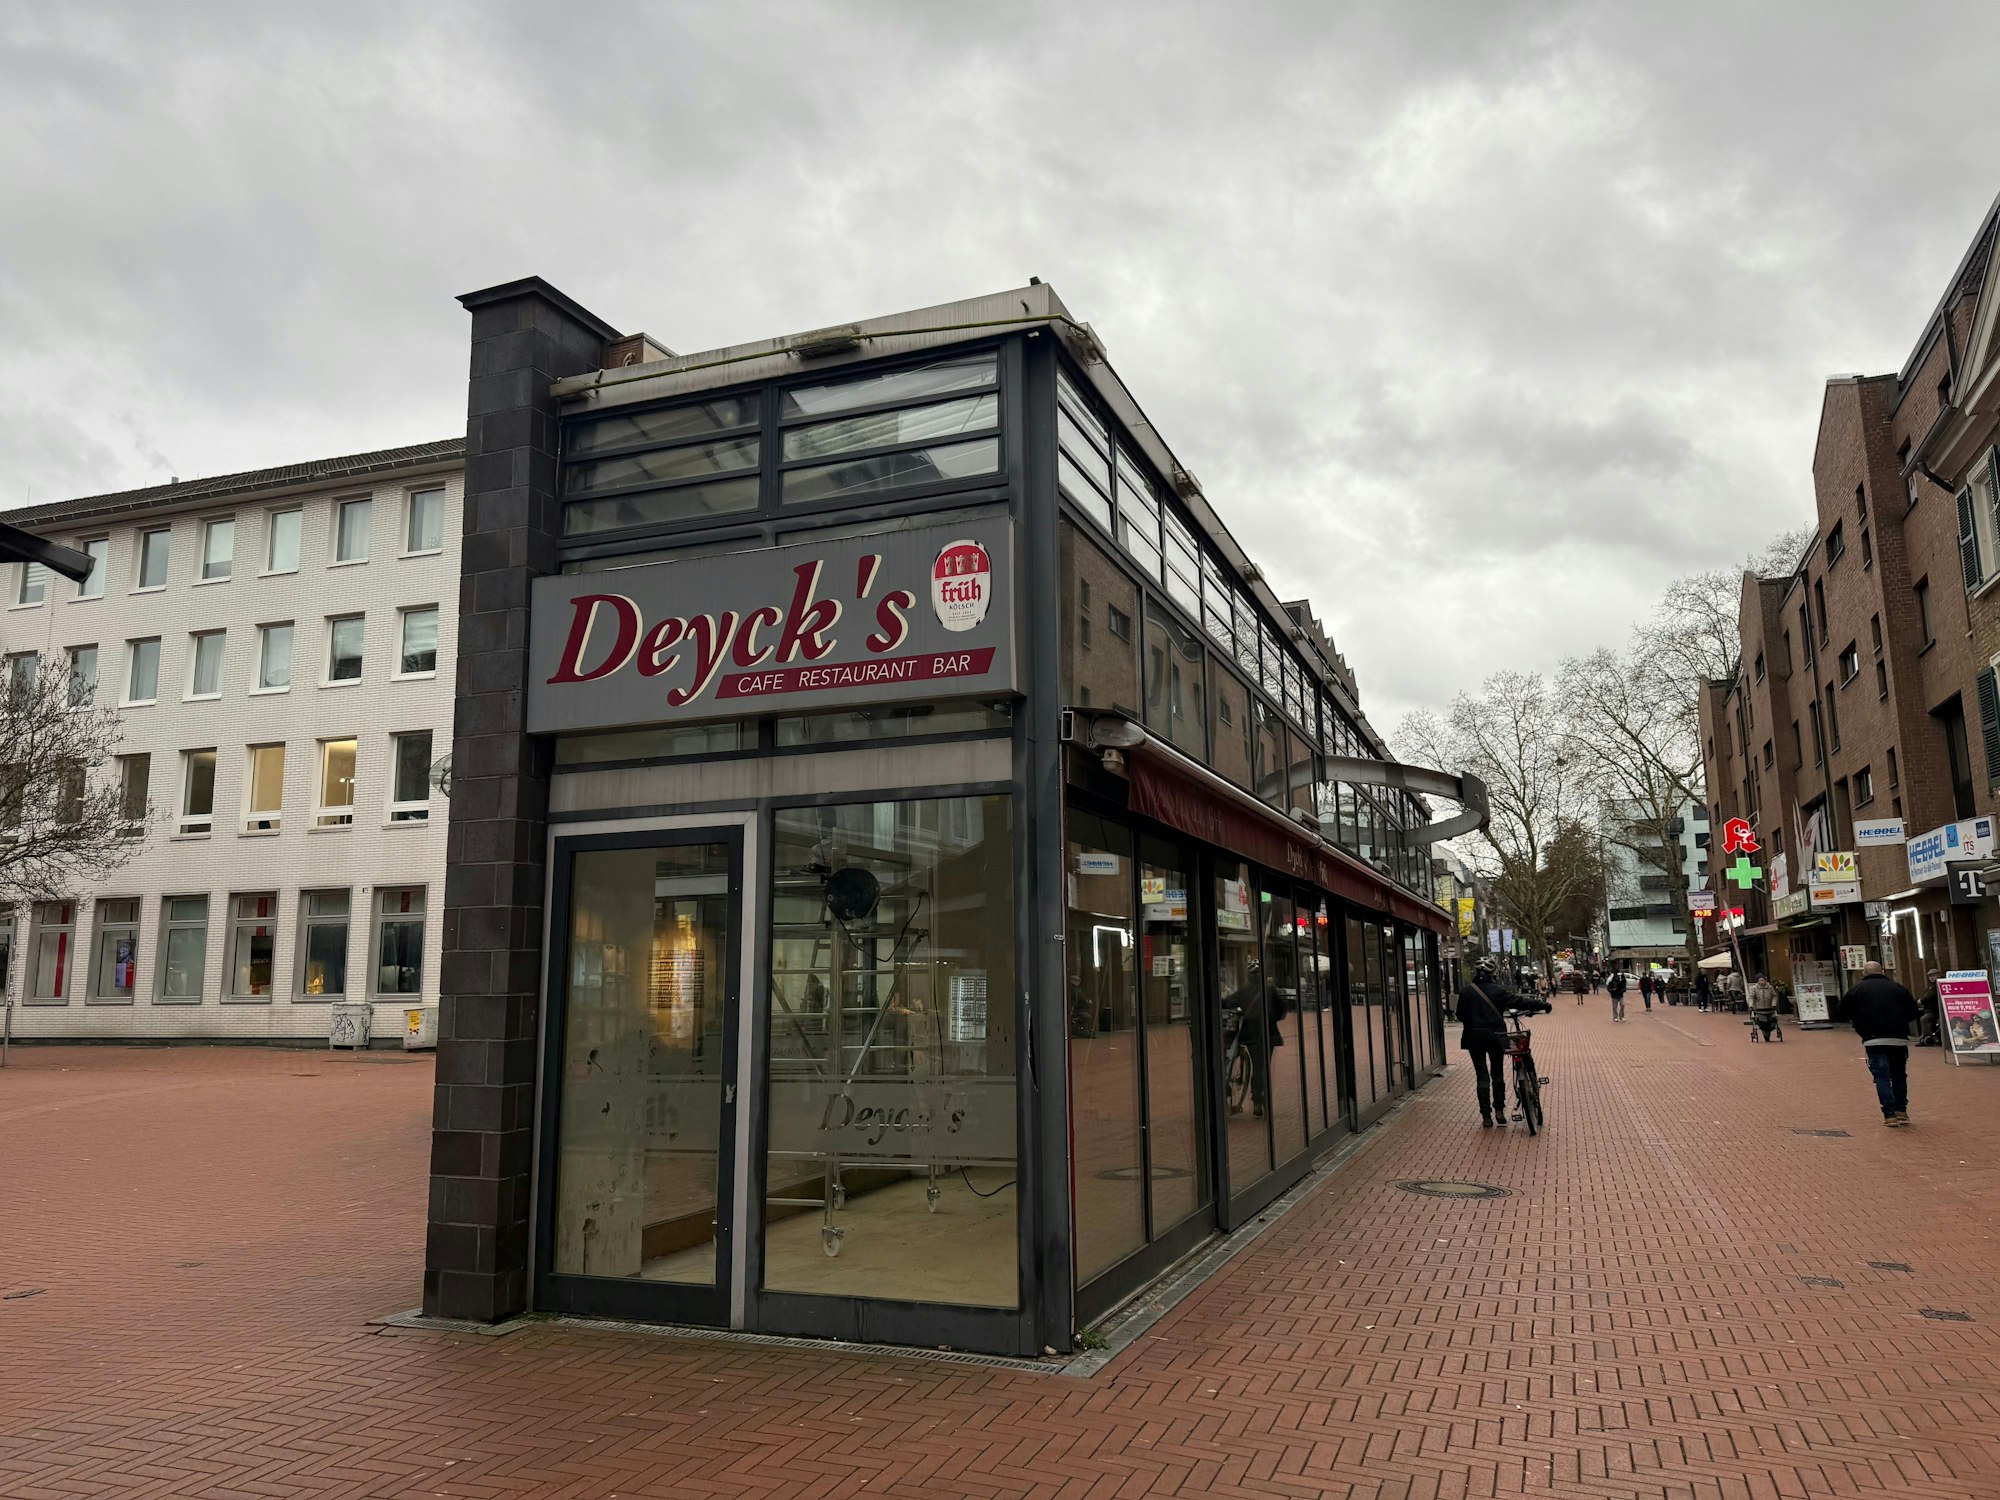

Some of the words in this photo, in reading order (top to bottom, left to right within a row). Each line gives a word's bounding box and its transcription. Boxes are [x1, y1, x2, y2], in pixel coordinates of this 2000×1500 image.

[941, 577, 981, 603] früh
[546, 554, 917, 707] Deyck's
[737, 673, 784, 693] CAFE
[799, 660, 918, 688] RESTAURANT
[932, 654, 971, 675] BAR
[1958, 870, 1986, 897] T
